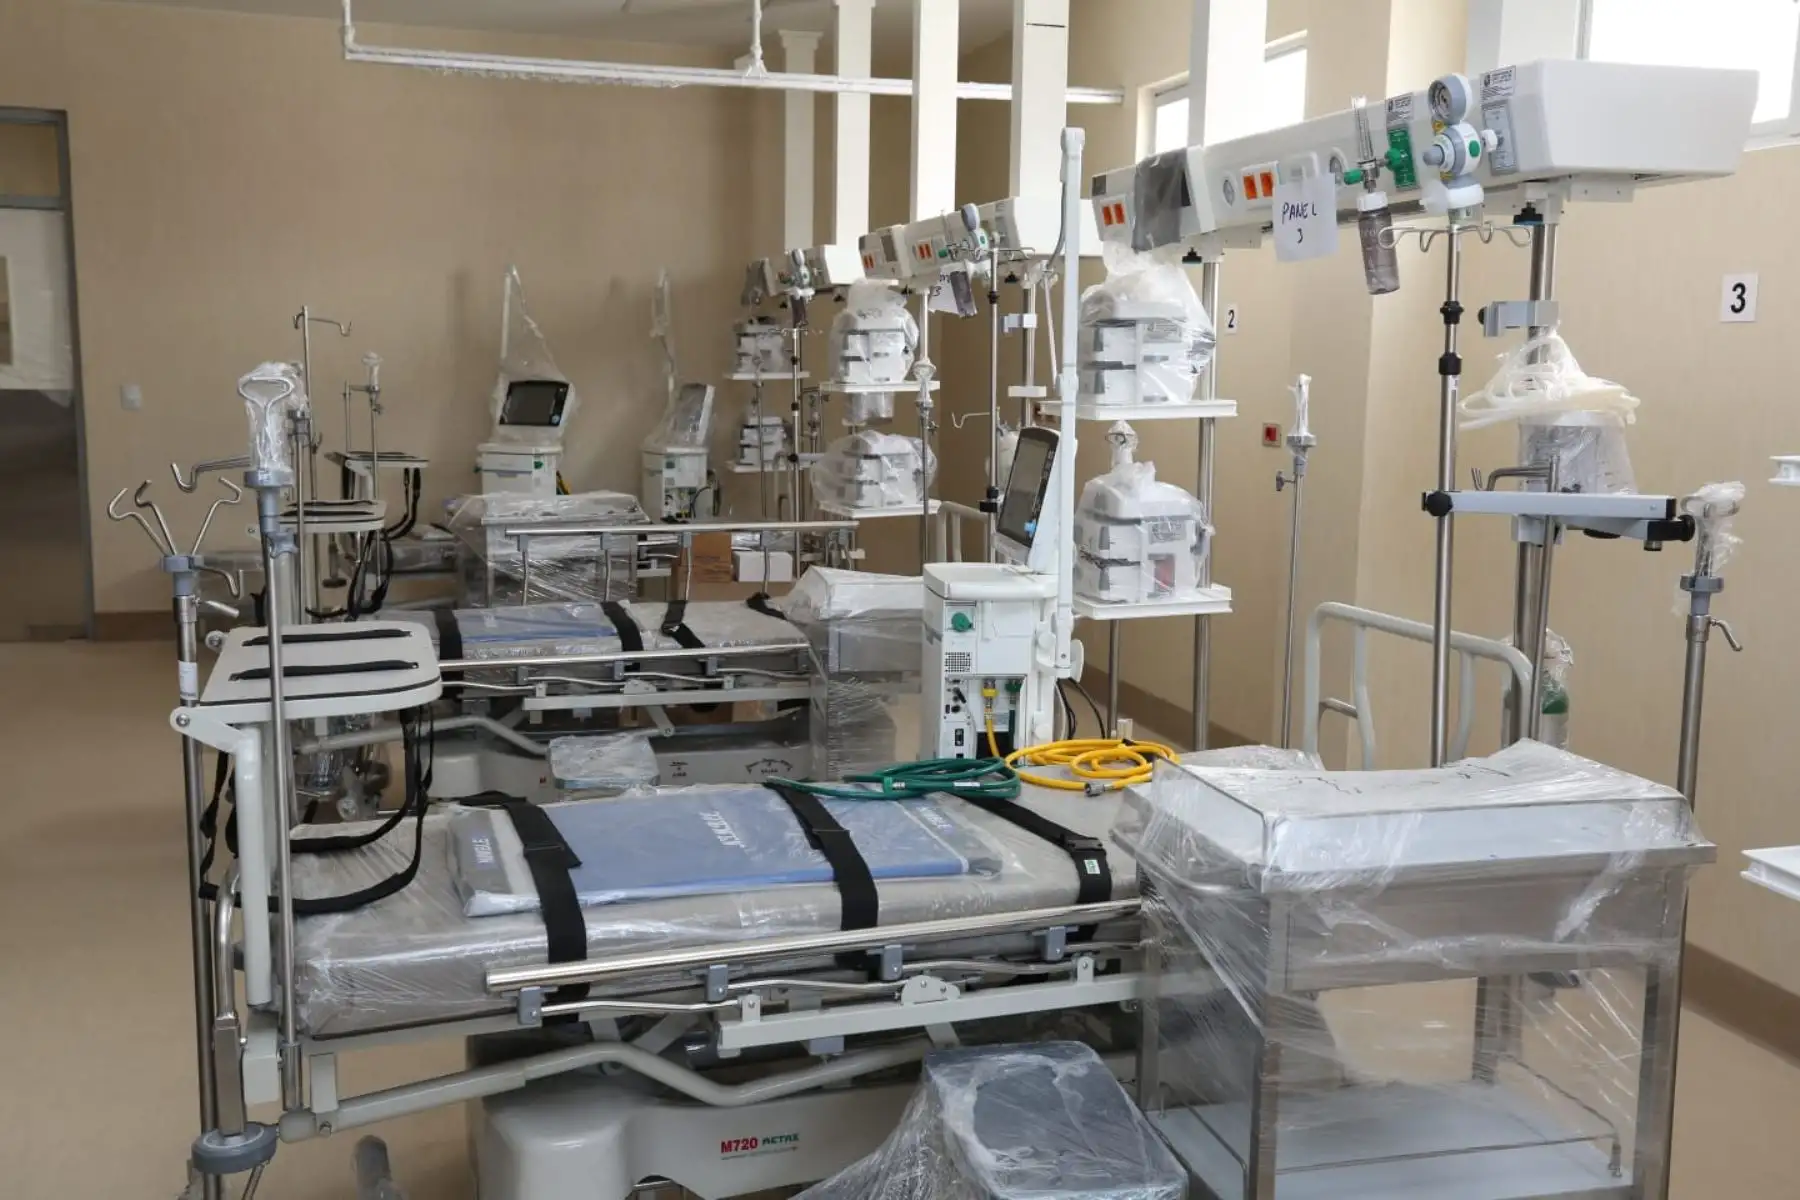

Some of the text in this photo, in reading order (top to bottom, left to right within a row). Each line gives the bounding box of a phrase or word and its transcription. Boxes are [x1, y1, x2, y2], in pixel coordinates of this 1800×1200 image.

[1282, 202, 1318, 225] PANEL
[1731, 282, 1746, 314] 3
[1228, 309, 1235, 328] 2
[721, 1137, 758, 1153] M720
